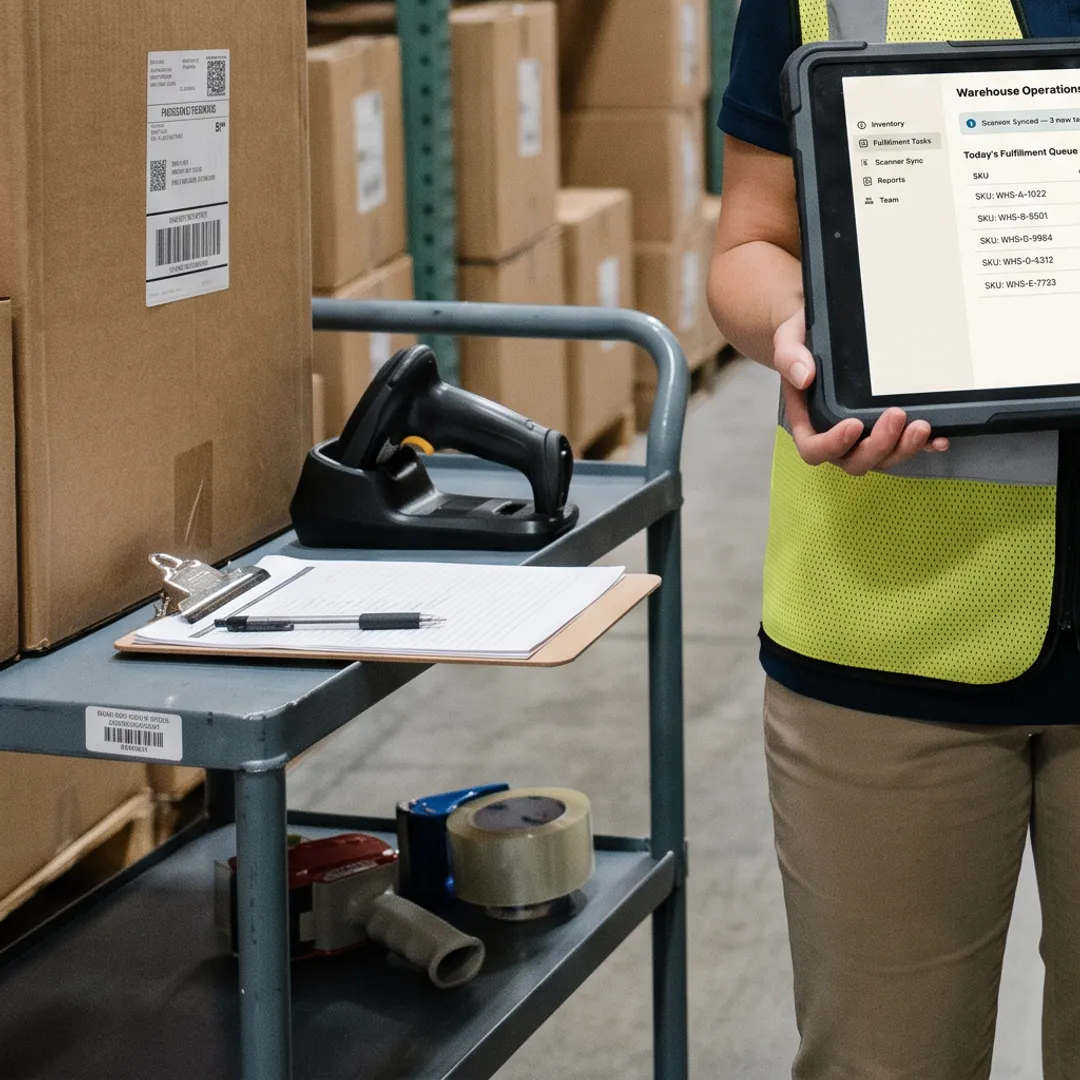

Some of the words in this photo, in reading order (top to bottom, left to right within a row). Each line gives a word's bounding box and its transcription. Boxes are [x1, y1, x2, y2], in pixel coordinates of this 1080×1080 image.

[956, 86, 1020, 98] Warehouse
[1012, 117, 1039, 127] Synced
[963, 149, 999, 160] Today's
[1000, 148, 1047, 158] Fulfillment
[1048, 147, 1078, 157] Queue
[973, 172, 989, 180] SKU
[975, 192, 995, 200] SKU:
[996, 190, 1047, 199] WHS-A-1022
[977, 214, 997, 223] SKU:
[980, 237, 999, 245] SKU:
[982, 258, 1001, 267] SKU:
[985, 281, 1004, 290] SKU:
